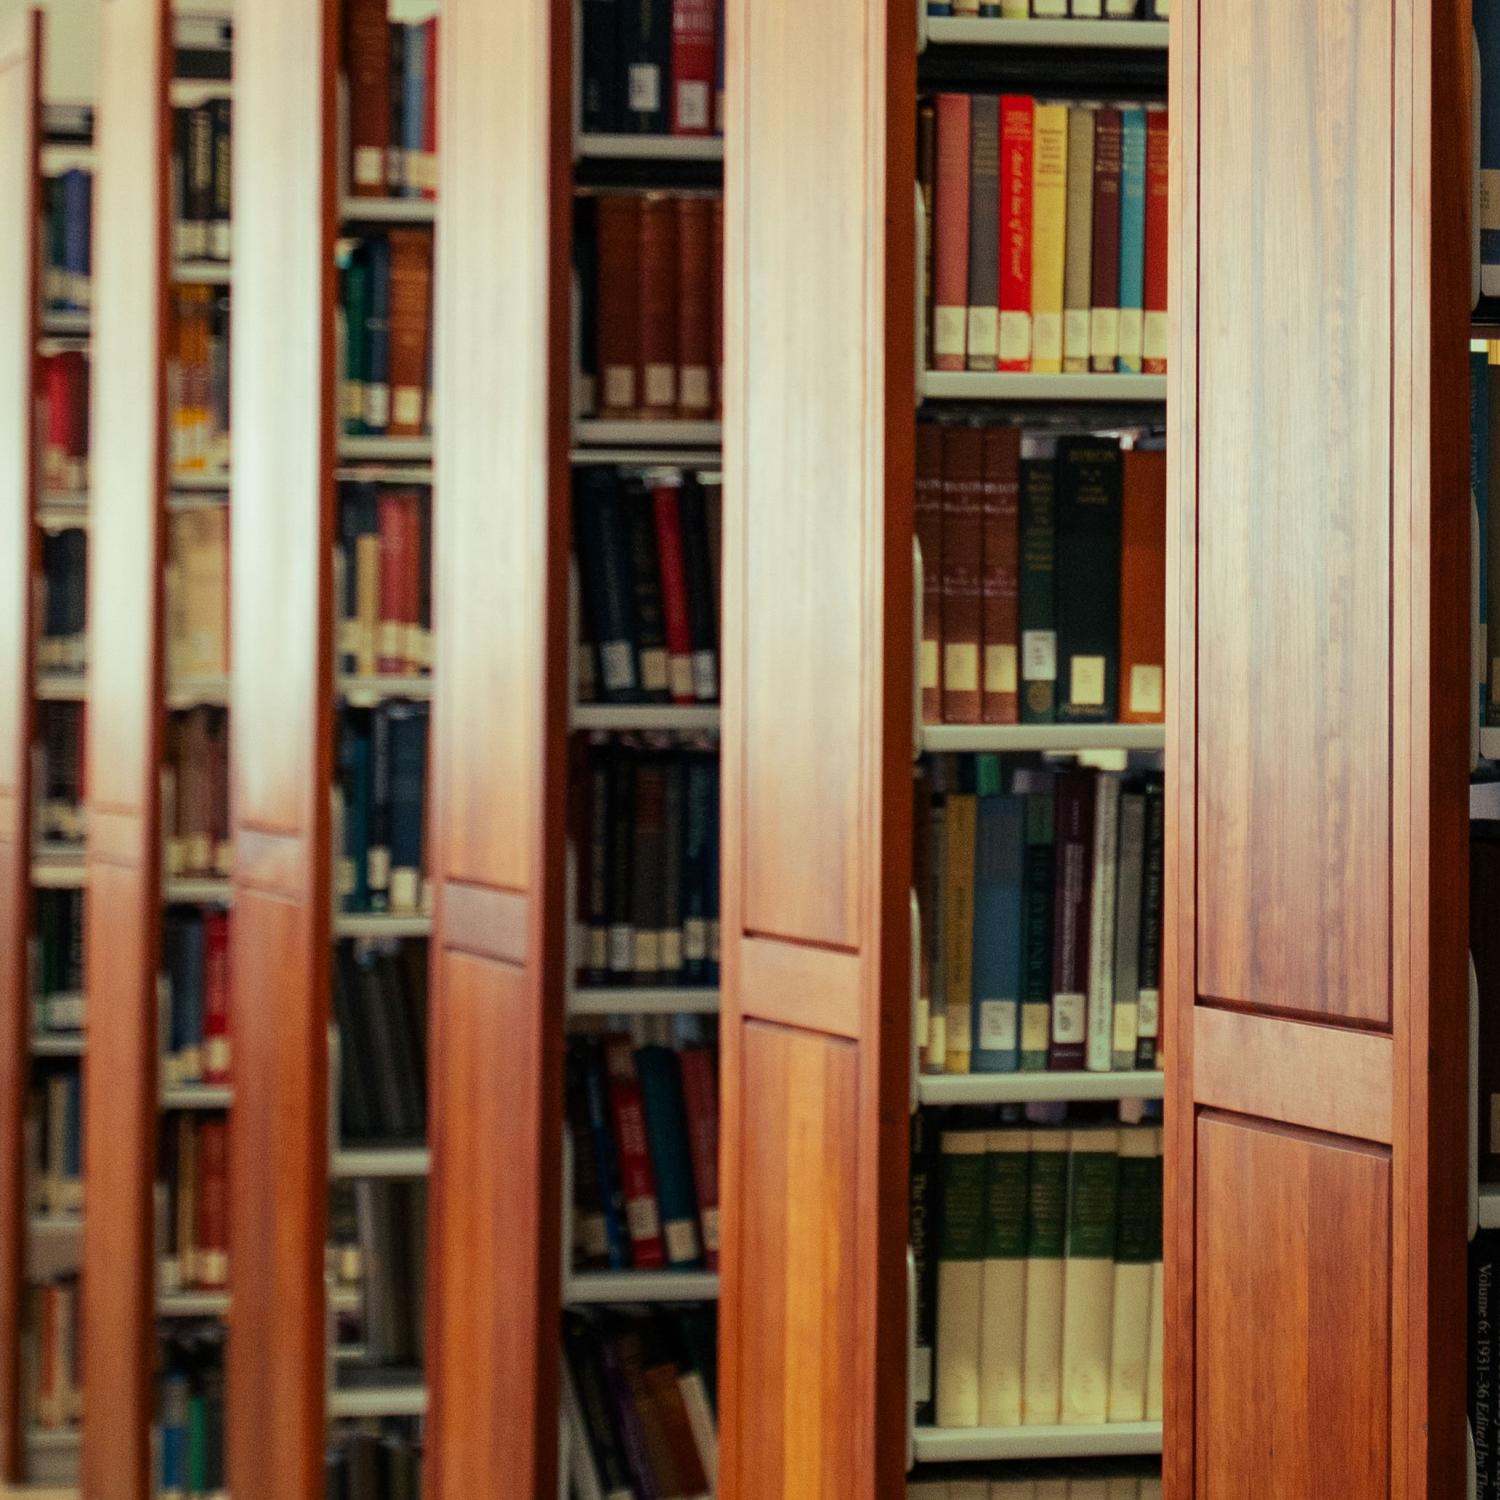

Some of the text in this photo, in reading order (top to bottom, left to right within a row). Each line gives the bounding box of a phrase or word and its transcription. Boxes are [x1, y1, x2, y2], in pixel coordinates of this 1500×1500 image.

[1478, 1263, 1492, 1317] Volume
[1478, 1320, 1490, 1333] 6:
[1475, 1401, 1489, 1449] Edited
[1475, 1451, 1488, 1468] by
